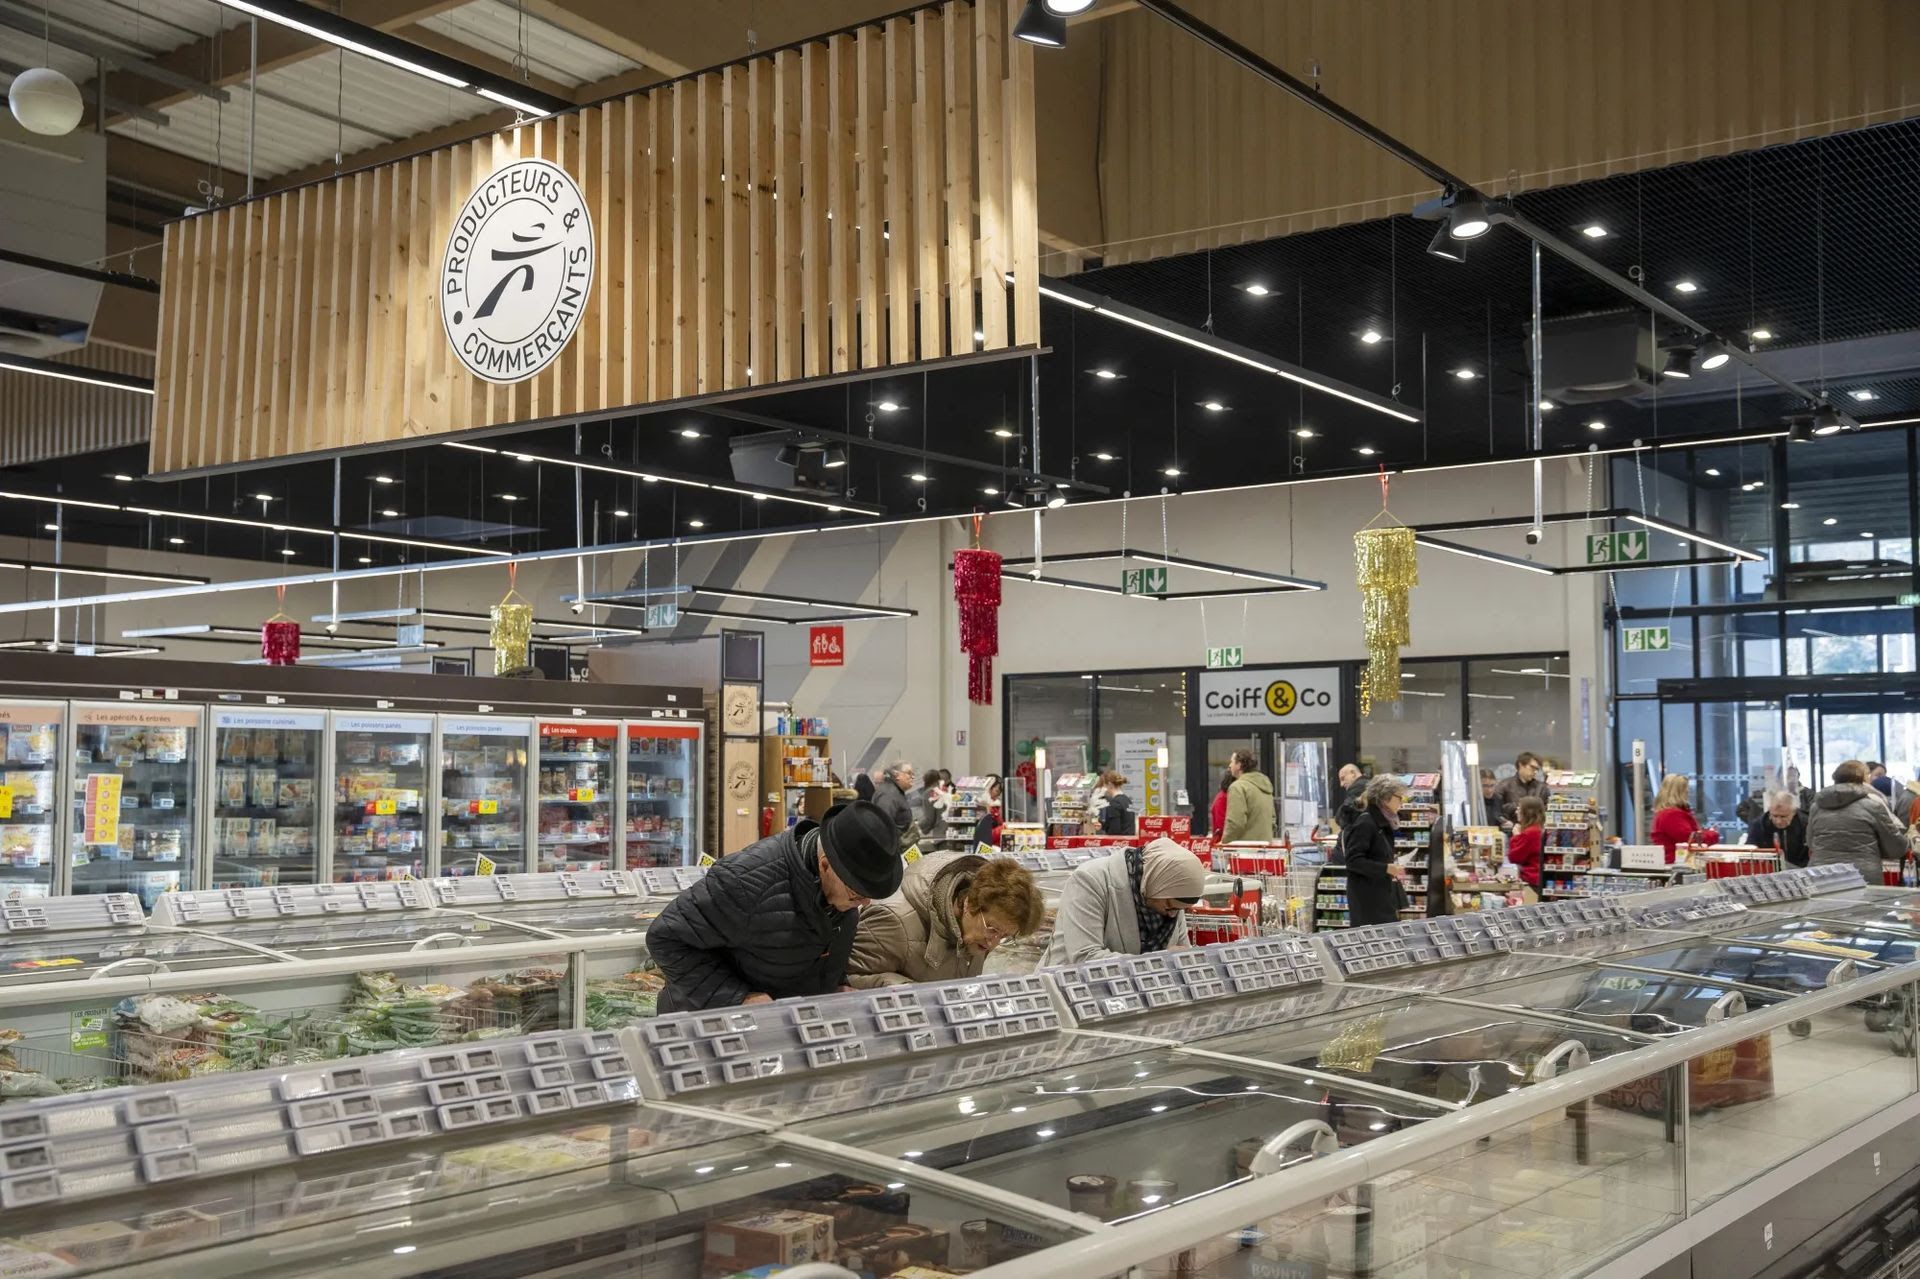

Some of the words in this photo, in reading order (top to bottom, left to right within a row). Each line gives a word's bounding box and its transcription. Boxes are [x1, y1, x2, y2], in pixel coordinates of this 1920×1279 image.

[447, 168, 563, 295] PRODUCTEURS
[563, 207, 580, 233] &
[463, 245, 587, 373] COMMERÇANTS
[1205, 687, 1262, 709] Coiff
[1273, 687, 1289, 709] &
[1300, 688, 1331, 707] Co
[96, 713, 108, 722] Les
[560, 727, 577, 735] viandes
